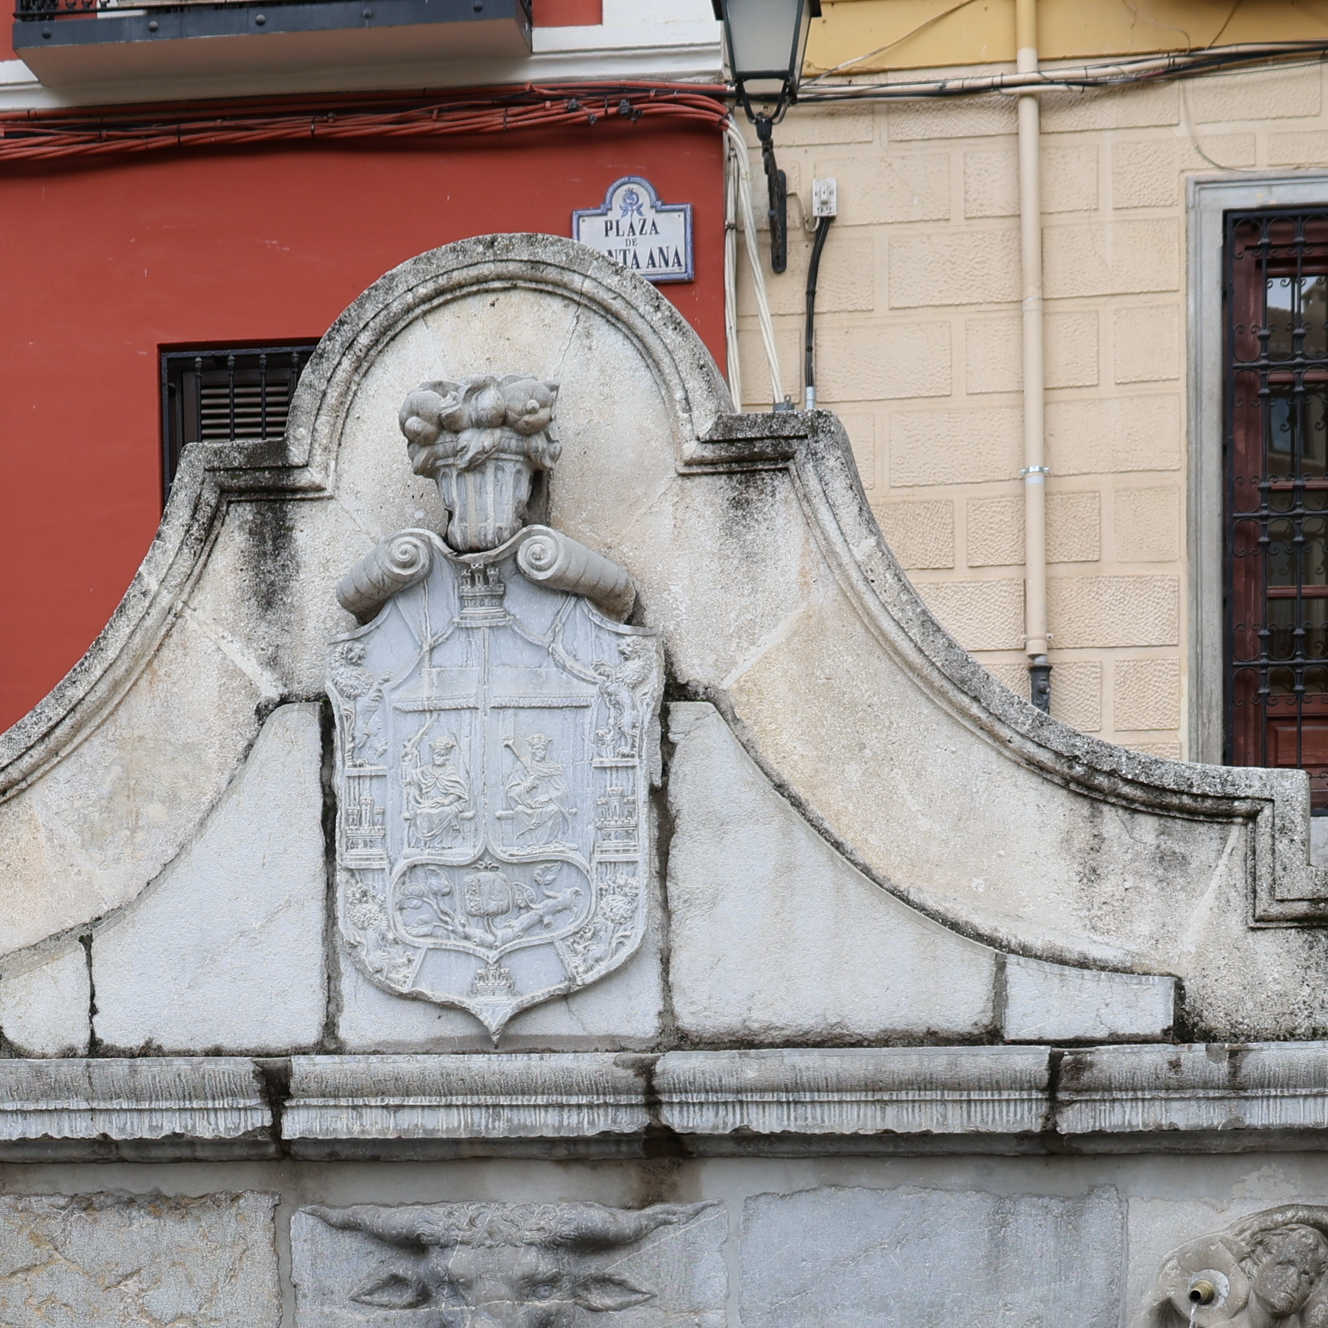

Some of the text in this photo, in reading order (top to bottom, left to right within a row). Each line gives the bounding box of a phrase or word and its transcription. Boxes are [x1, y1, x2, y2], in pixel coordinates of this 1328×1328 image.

[604, 219, 660, 237] PLAZA
[625, 238, 638, 247] DE
[607, 245, 683, 269] NTA ANA
